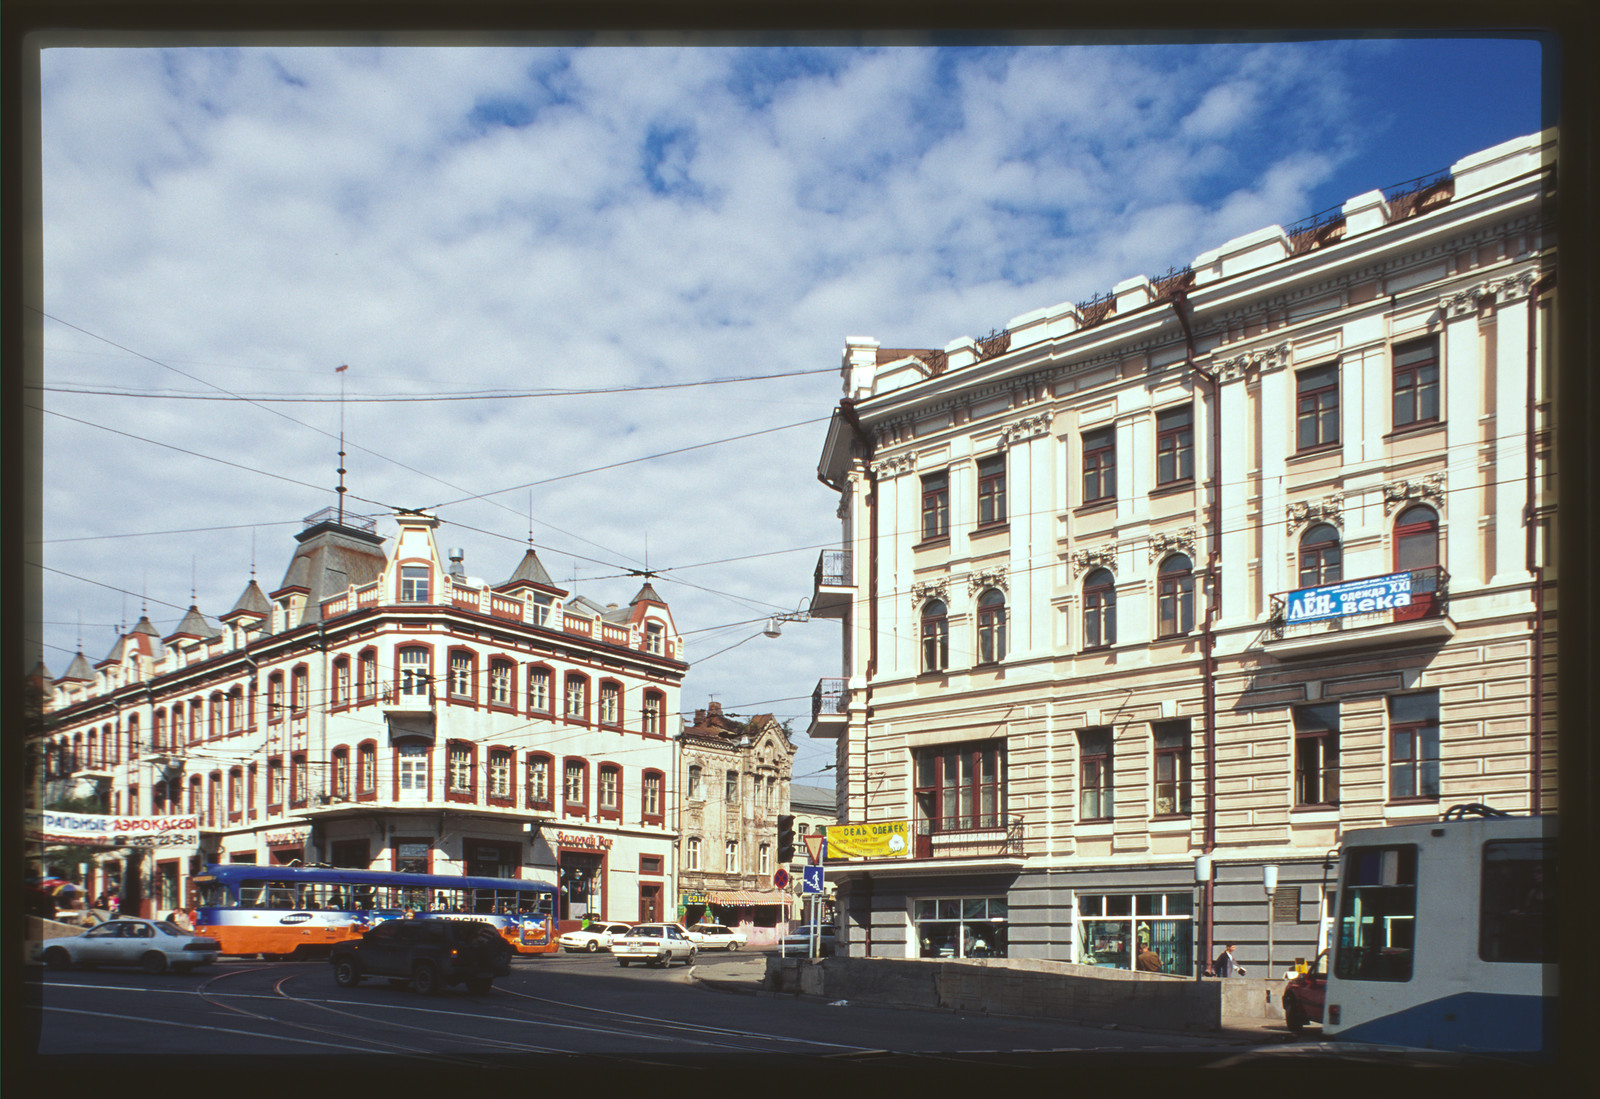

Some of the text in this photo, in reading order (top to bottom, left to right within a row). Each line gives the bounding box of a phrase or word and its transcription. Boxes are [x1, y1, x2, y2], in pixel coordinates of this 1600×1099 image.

[1340, 586, 1384, 601] одежда
[1388, 580, 1410, 593] XXI
[1342, 593, 1410, 613] века
[114, 818, 197, 831] АЭРОКАССЫ
